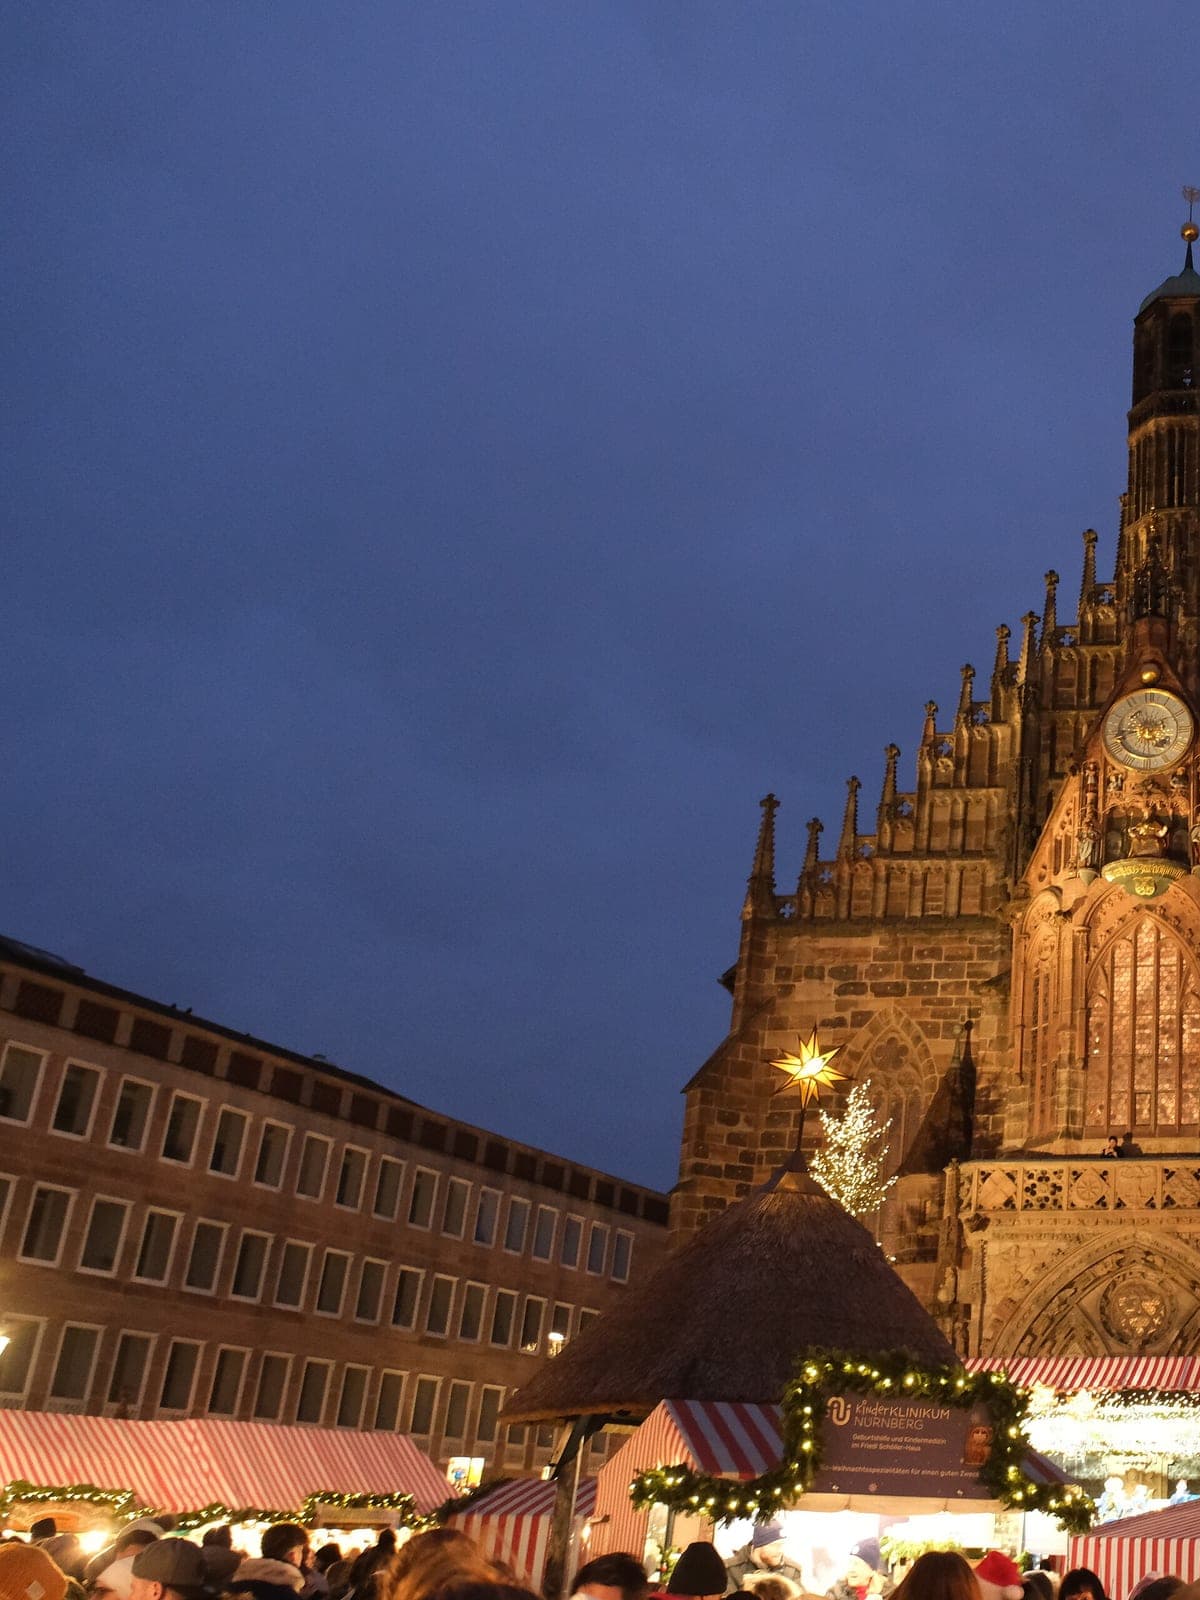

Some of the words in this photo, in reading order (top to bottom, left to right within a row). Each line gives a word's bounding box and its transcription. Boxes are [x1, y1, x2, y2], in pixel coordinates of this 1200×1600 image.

[890, 1435, 903, 1443] und
[910, 1467, 921, 1475] für
[940, 1469, 959, 1478] guten
